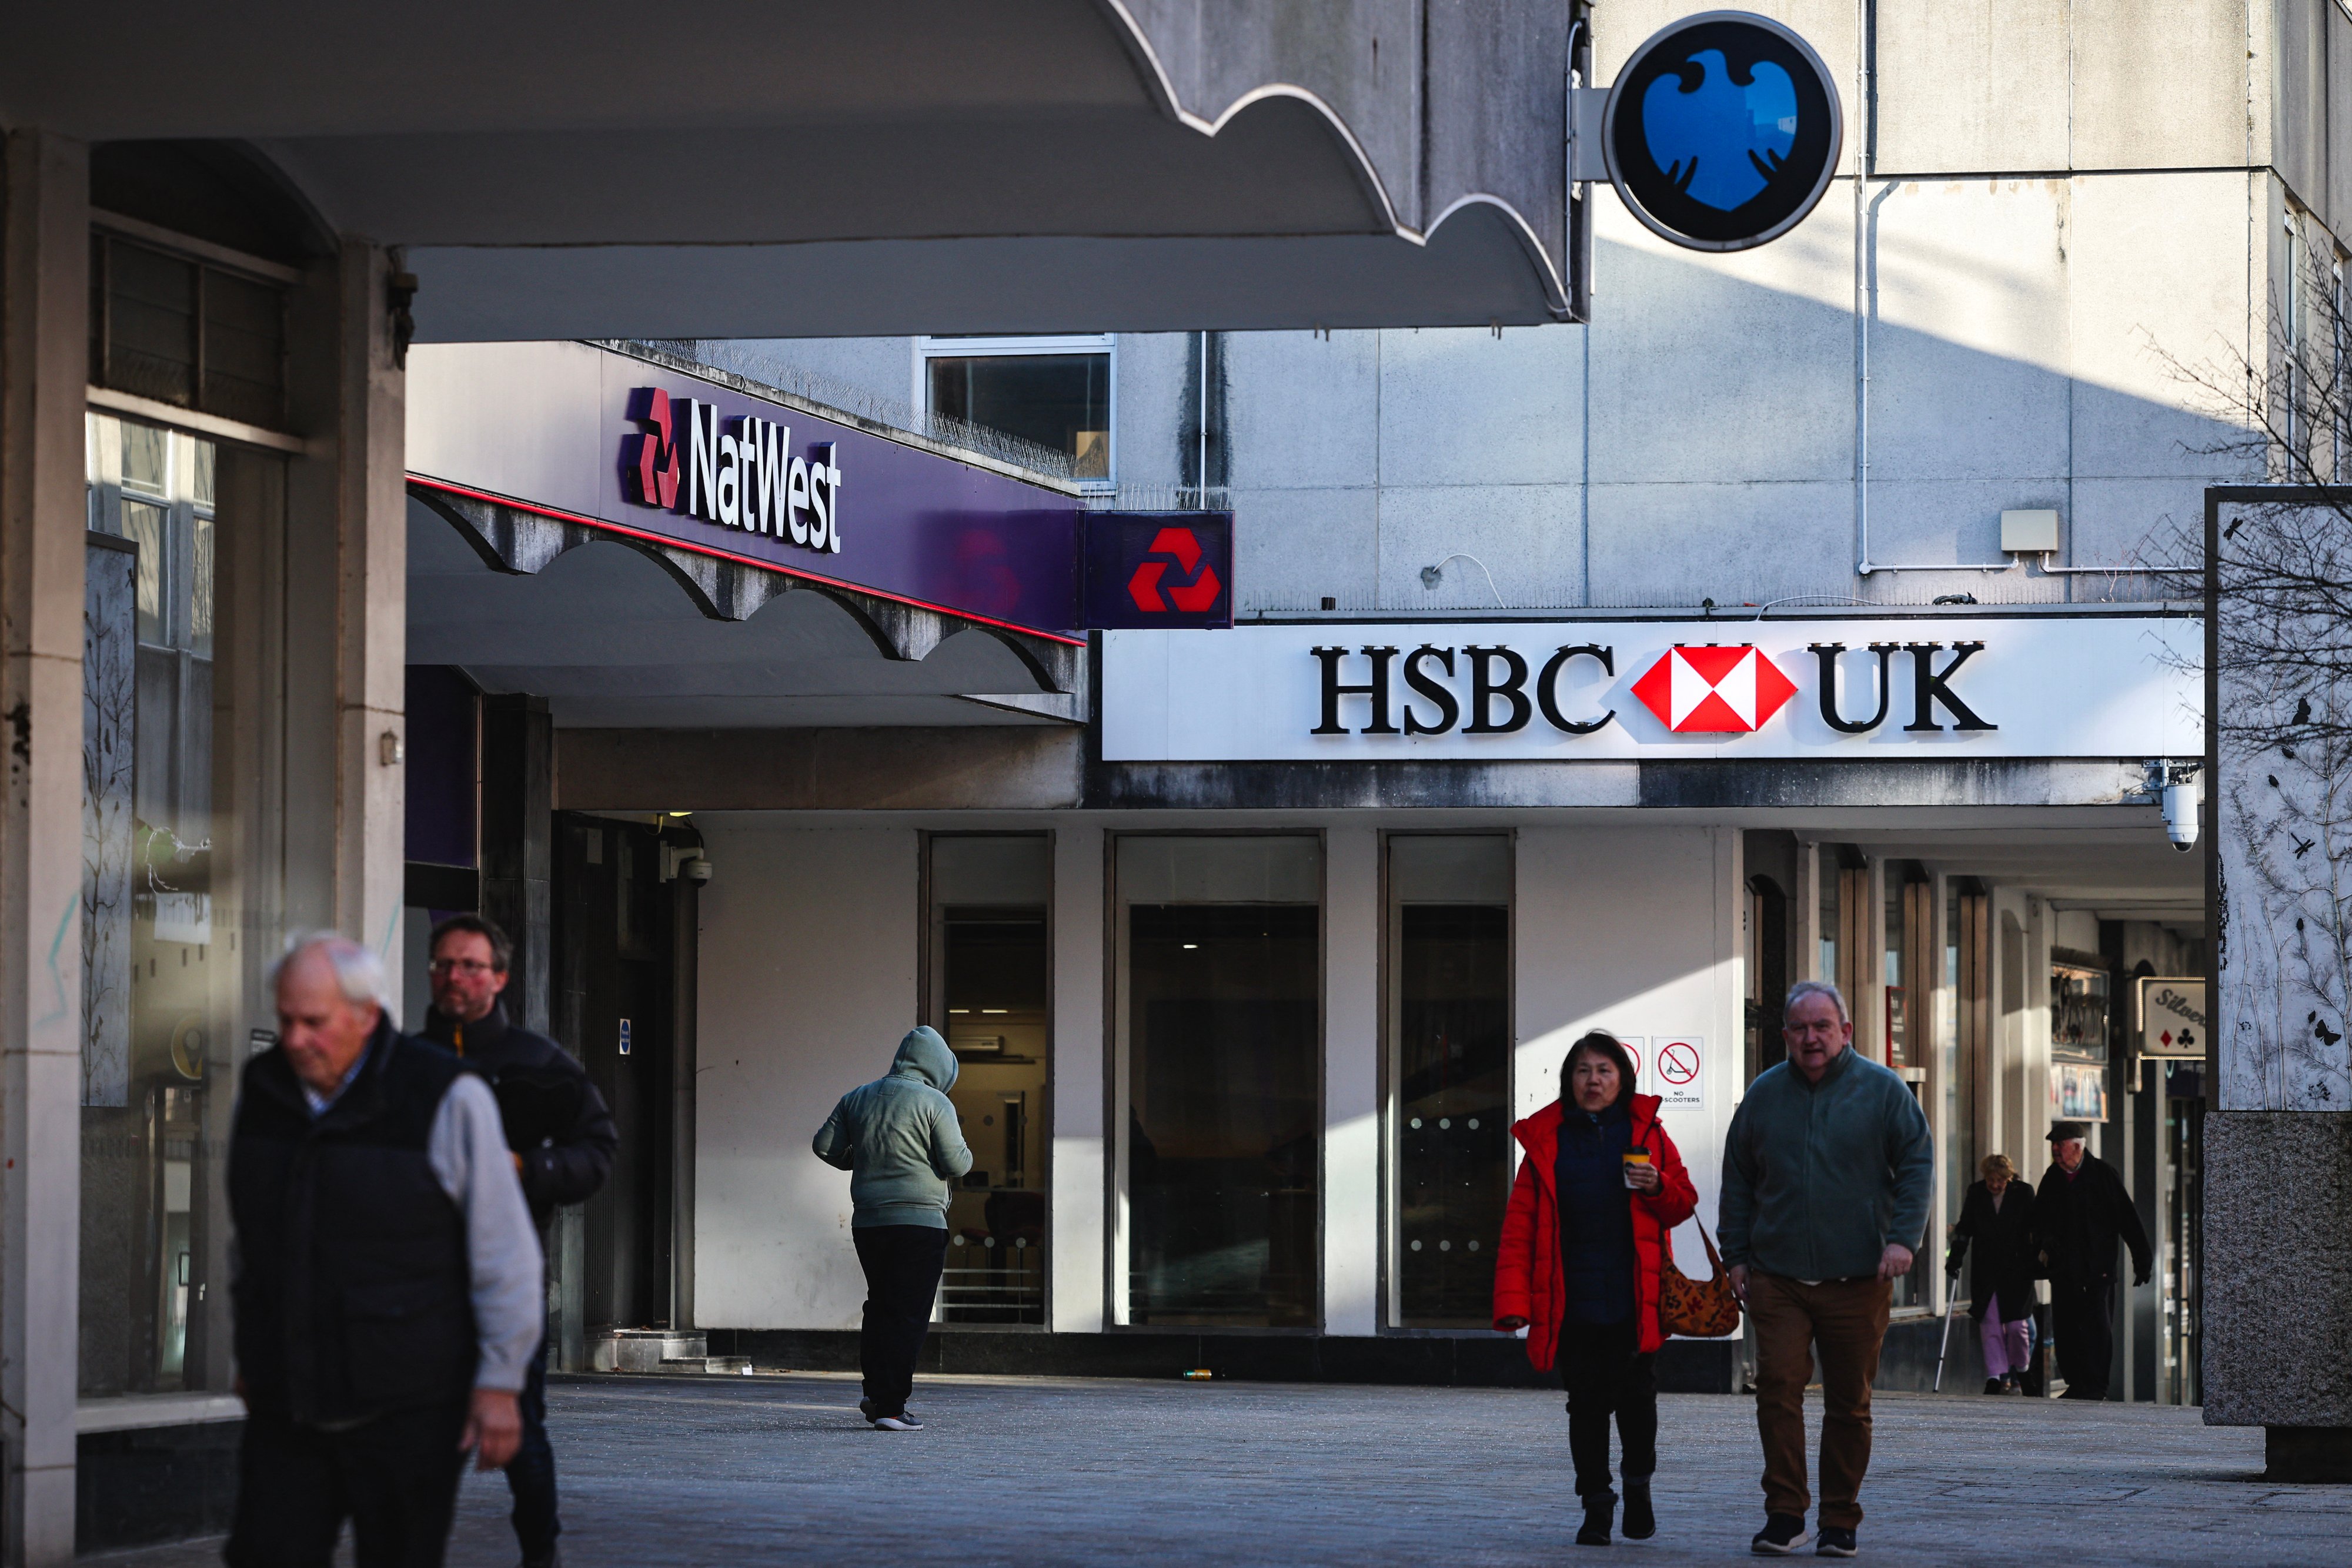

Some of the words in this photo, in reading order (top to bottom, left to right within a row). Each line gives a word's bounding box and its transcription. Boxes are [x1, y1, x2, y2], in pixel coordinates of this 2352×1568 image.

[689, 397, 841, 554] NatWest
[1310, 644, 1616, 735] HSBC
[1807, 640, 1999, 733] UK
